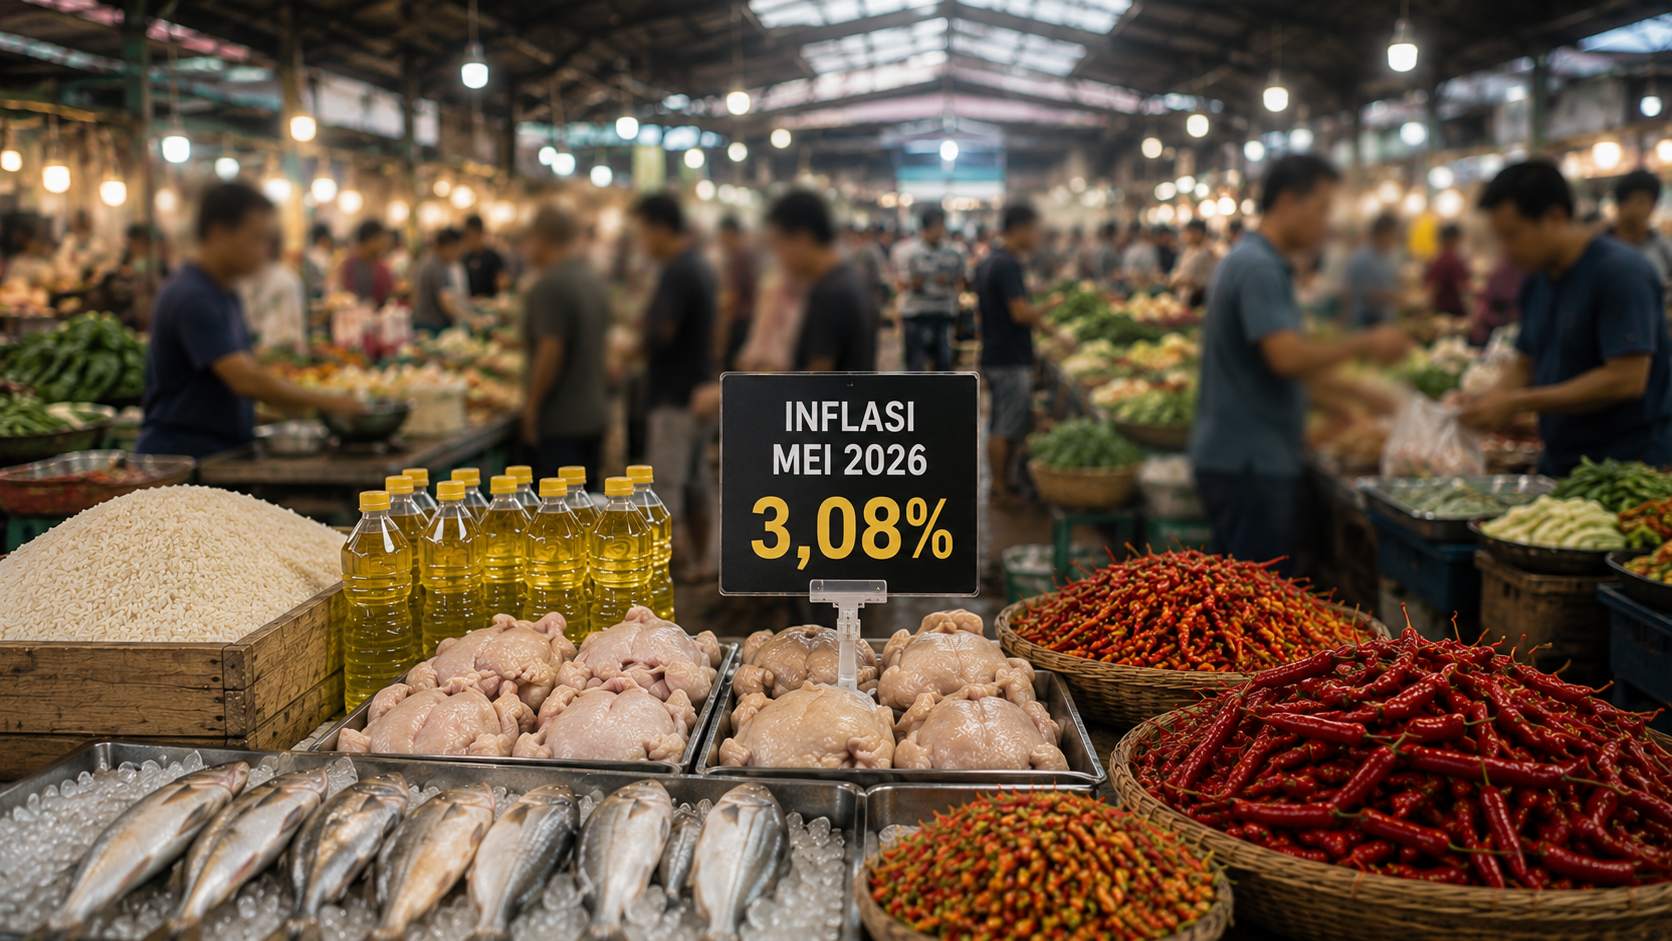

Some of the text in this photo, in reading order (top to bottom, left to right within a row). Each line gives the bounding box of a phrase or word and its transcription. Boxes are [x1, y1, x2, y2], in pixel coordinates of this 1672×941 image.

[785, 401, 915, 432] INFLASI
[773, 444, 928, 475] MEI 2026
[752, 496, 954, 570] 3,08%
